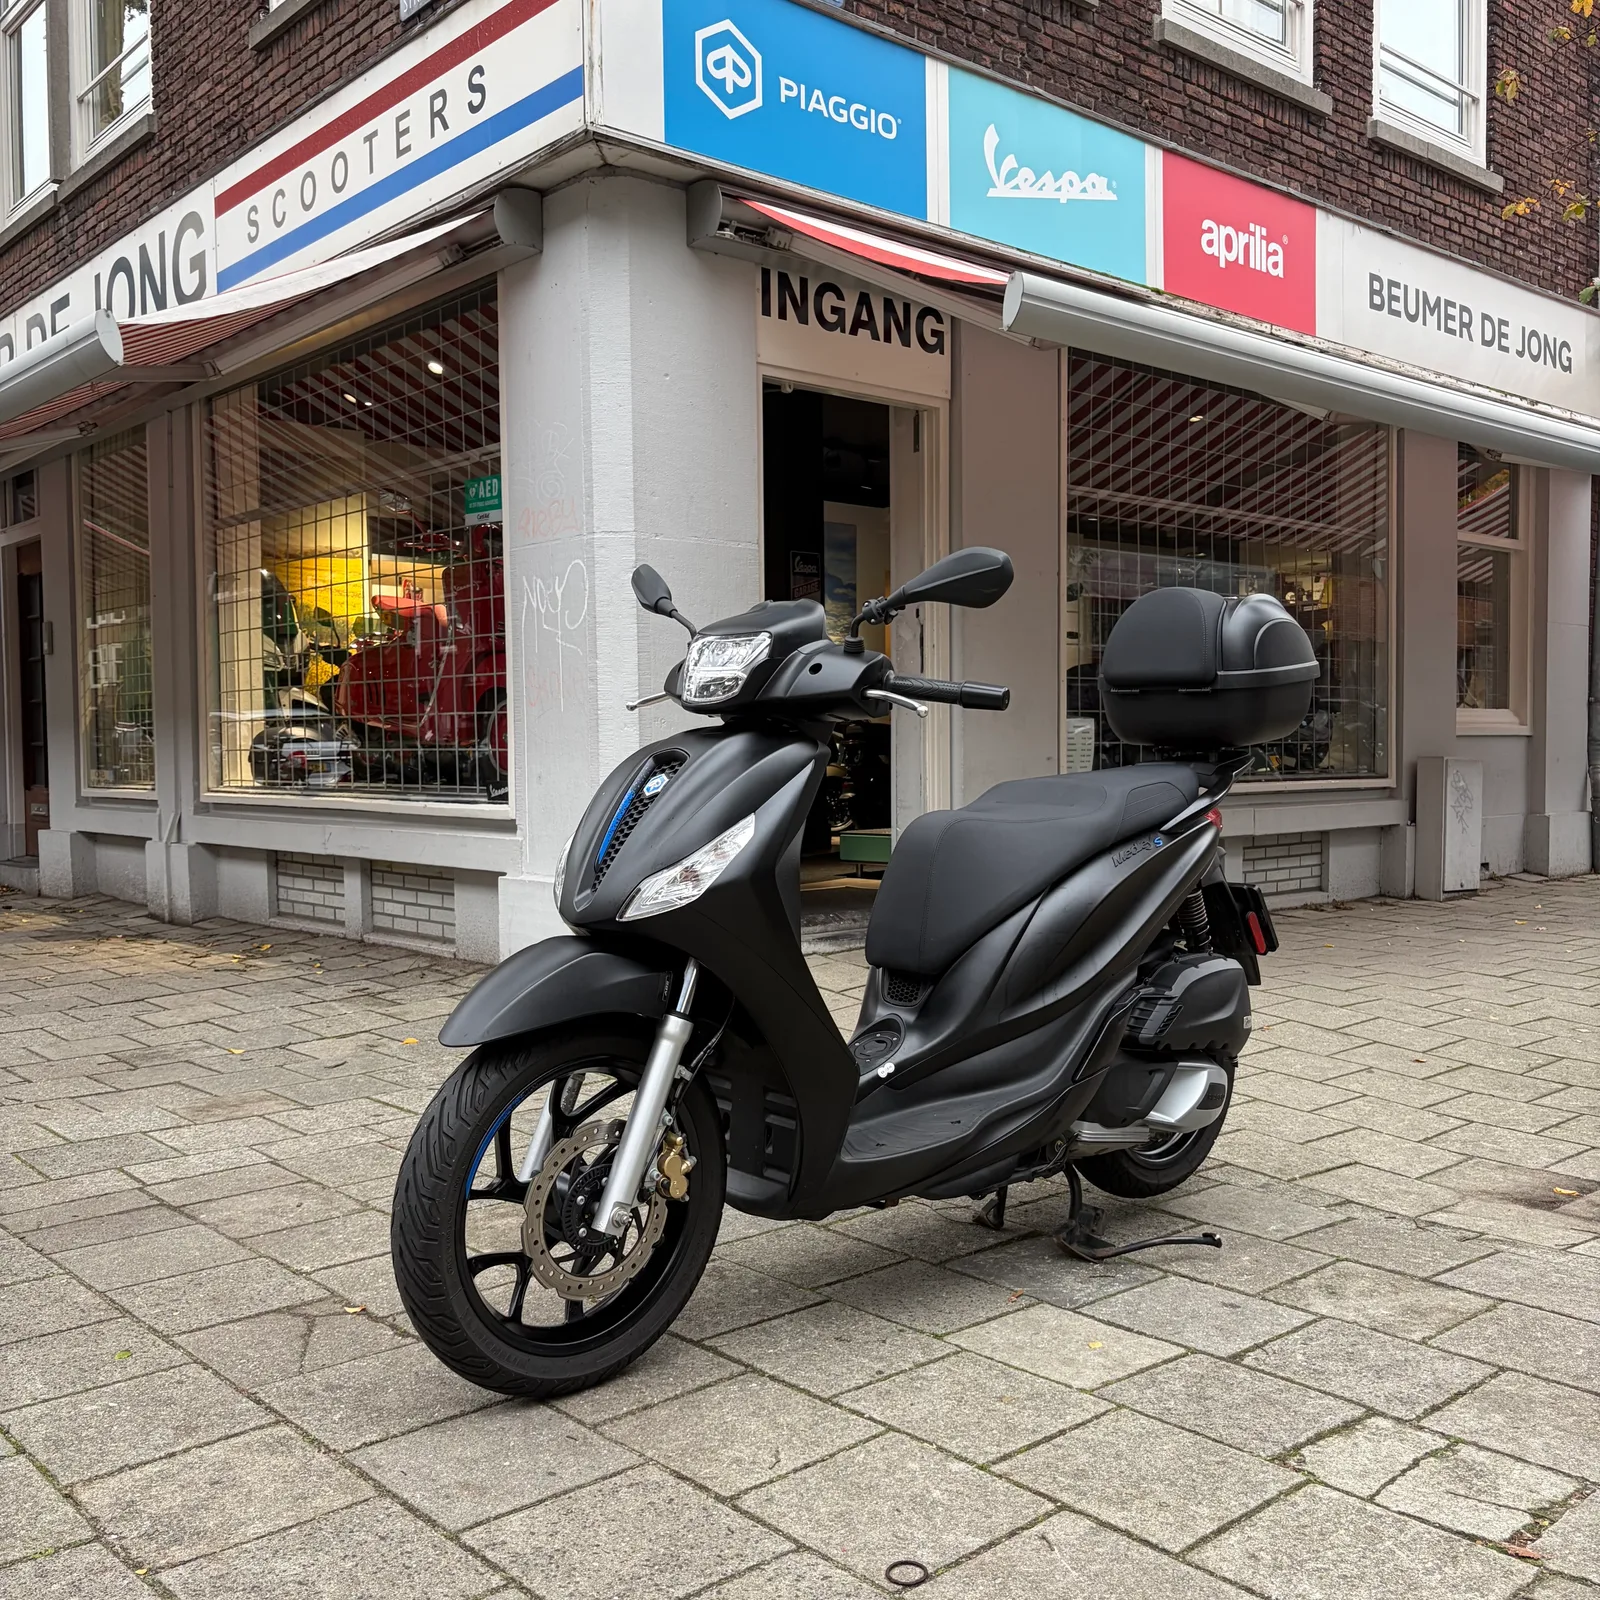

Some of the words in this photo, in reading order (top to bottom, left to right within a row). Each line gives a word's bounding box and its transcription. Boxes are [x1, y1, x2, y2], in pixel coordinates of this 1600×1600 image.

[779, 76, 897, 140] PIAGGIO
[247, 64, 486, 244] SCOOTERS
[983, 123, 1118, 204] Vespa
[1200, 218, 1285, 279] aprilia
[760, 267, 946, 356] INGANG
[1368, 272, 1474, 342] BEUMER
[1481, 312, 1511, 355] DE
[1515, 325, 1573, 375] JONG
[478, 478, 499, 498] AED
[794, 582, 819, 598] GARAGE
